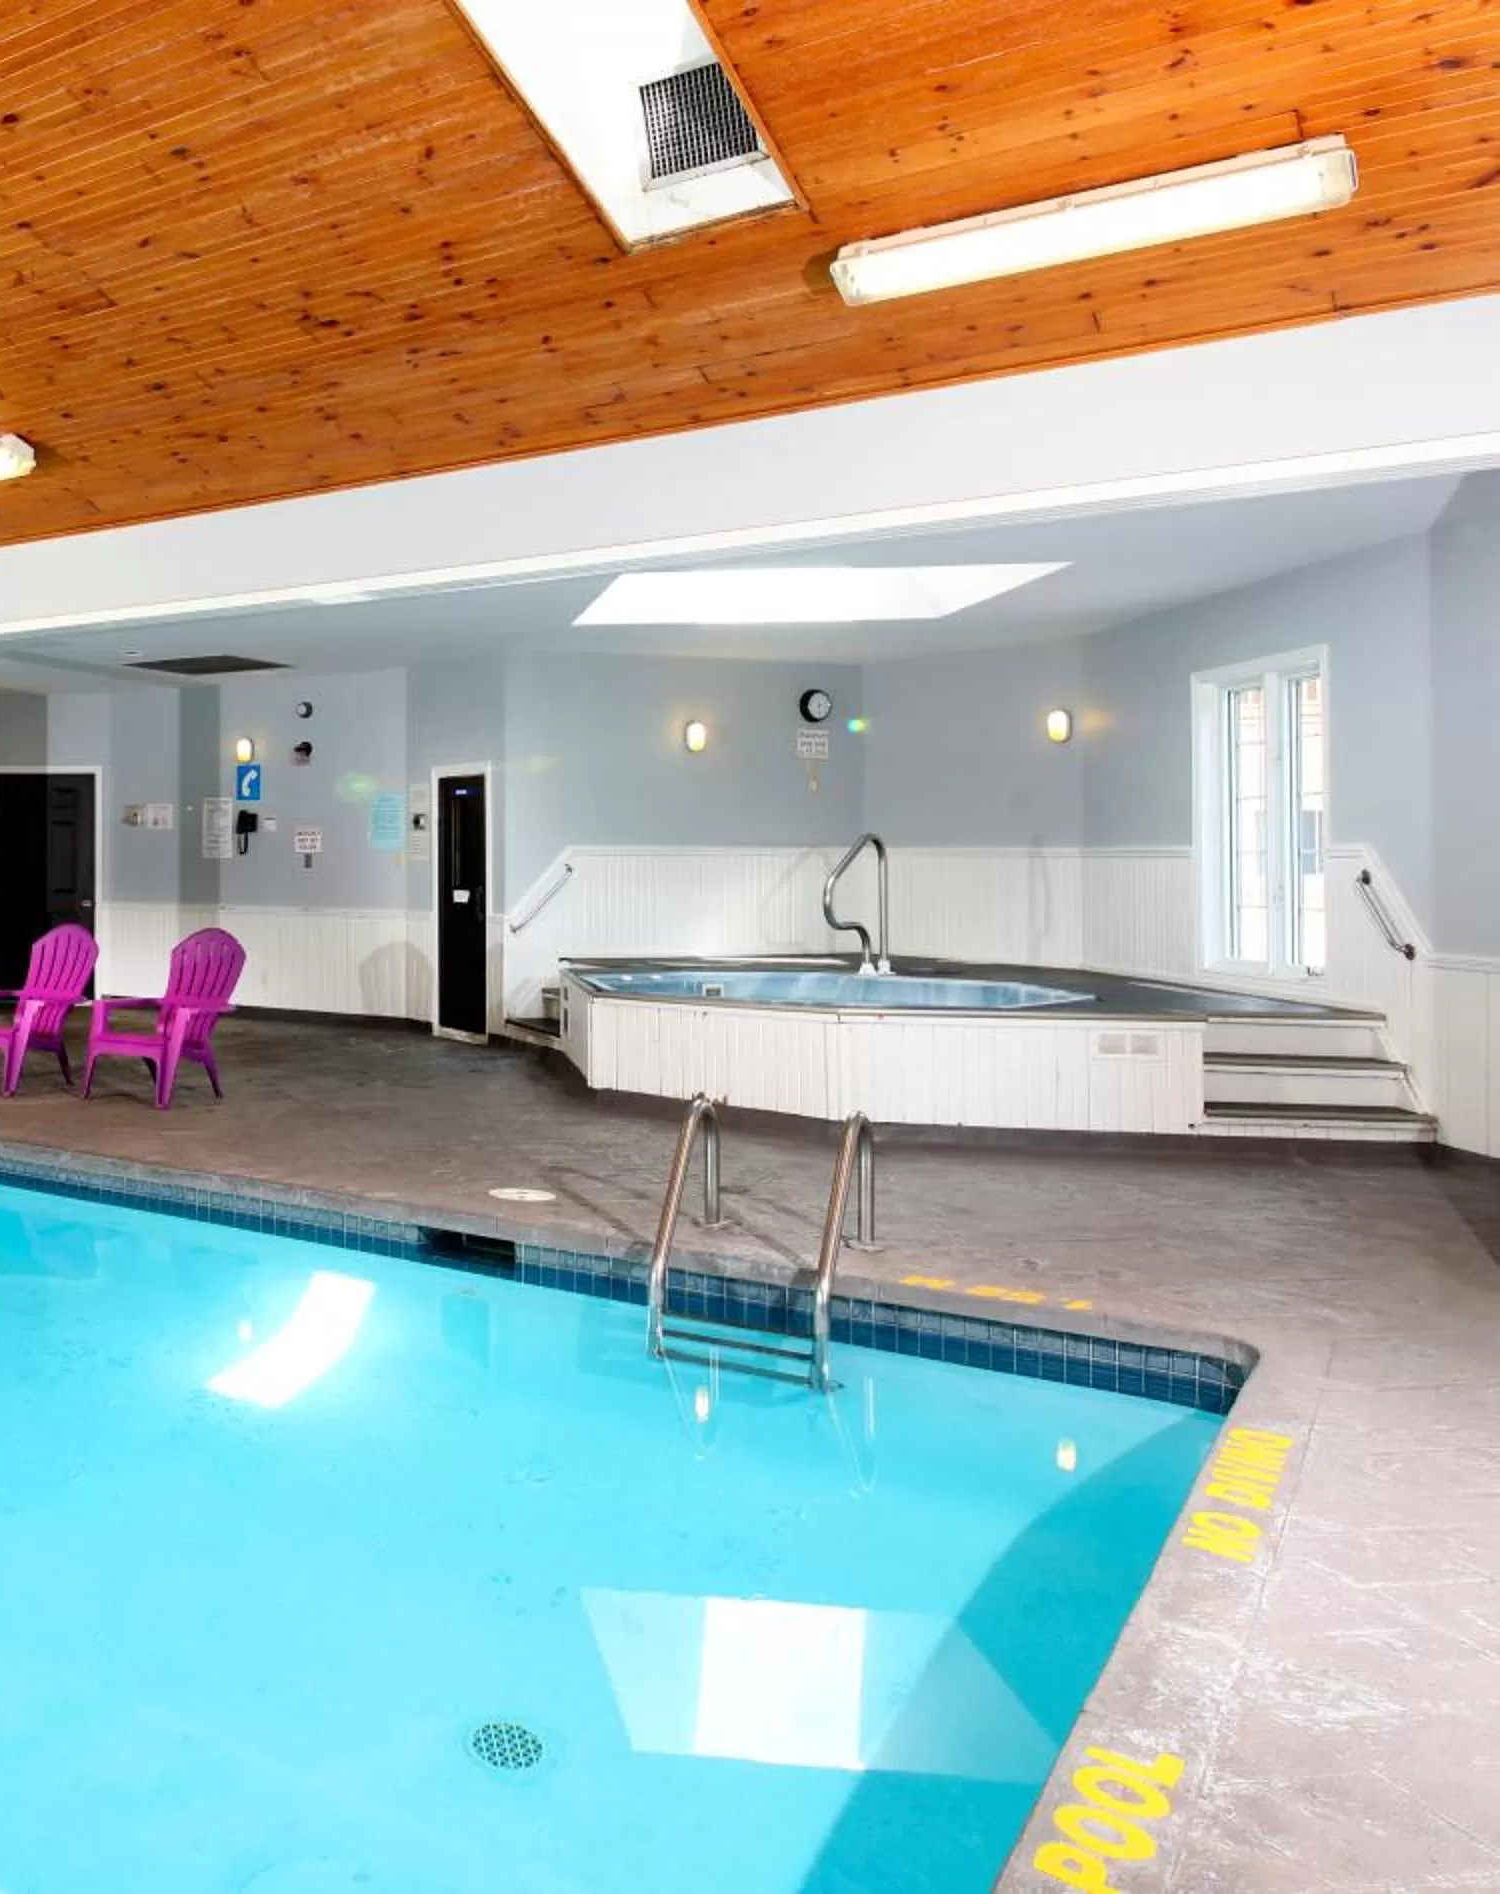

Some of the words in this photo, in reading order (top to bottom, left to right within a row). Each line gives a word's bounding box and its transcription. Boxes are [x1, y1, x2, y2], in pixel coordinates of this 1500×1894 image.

[1204, 1427, 1293, 1510] DIVING
[1182, 1511, 1263, 1562] NO
[1033, 1745, 1185, 1894] POOL
